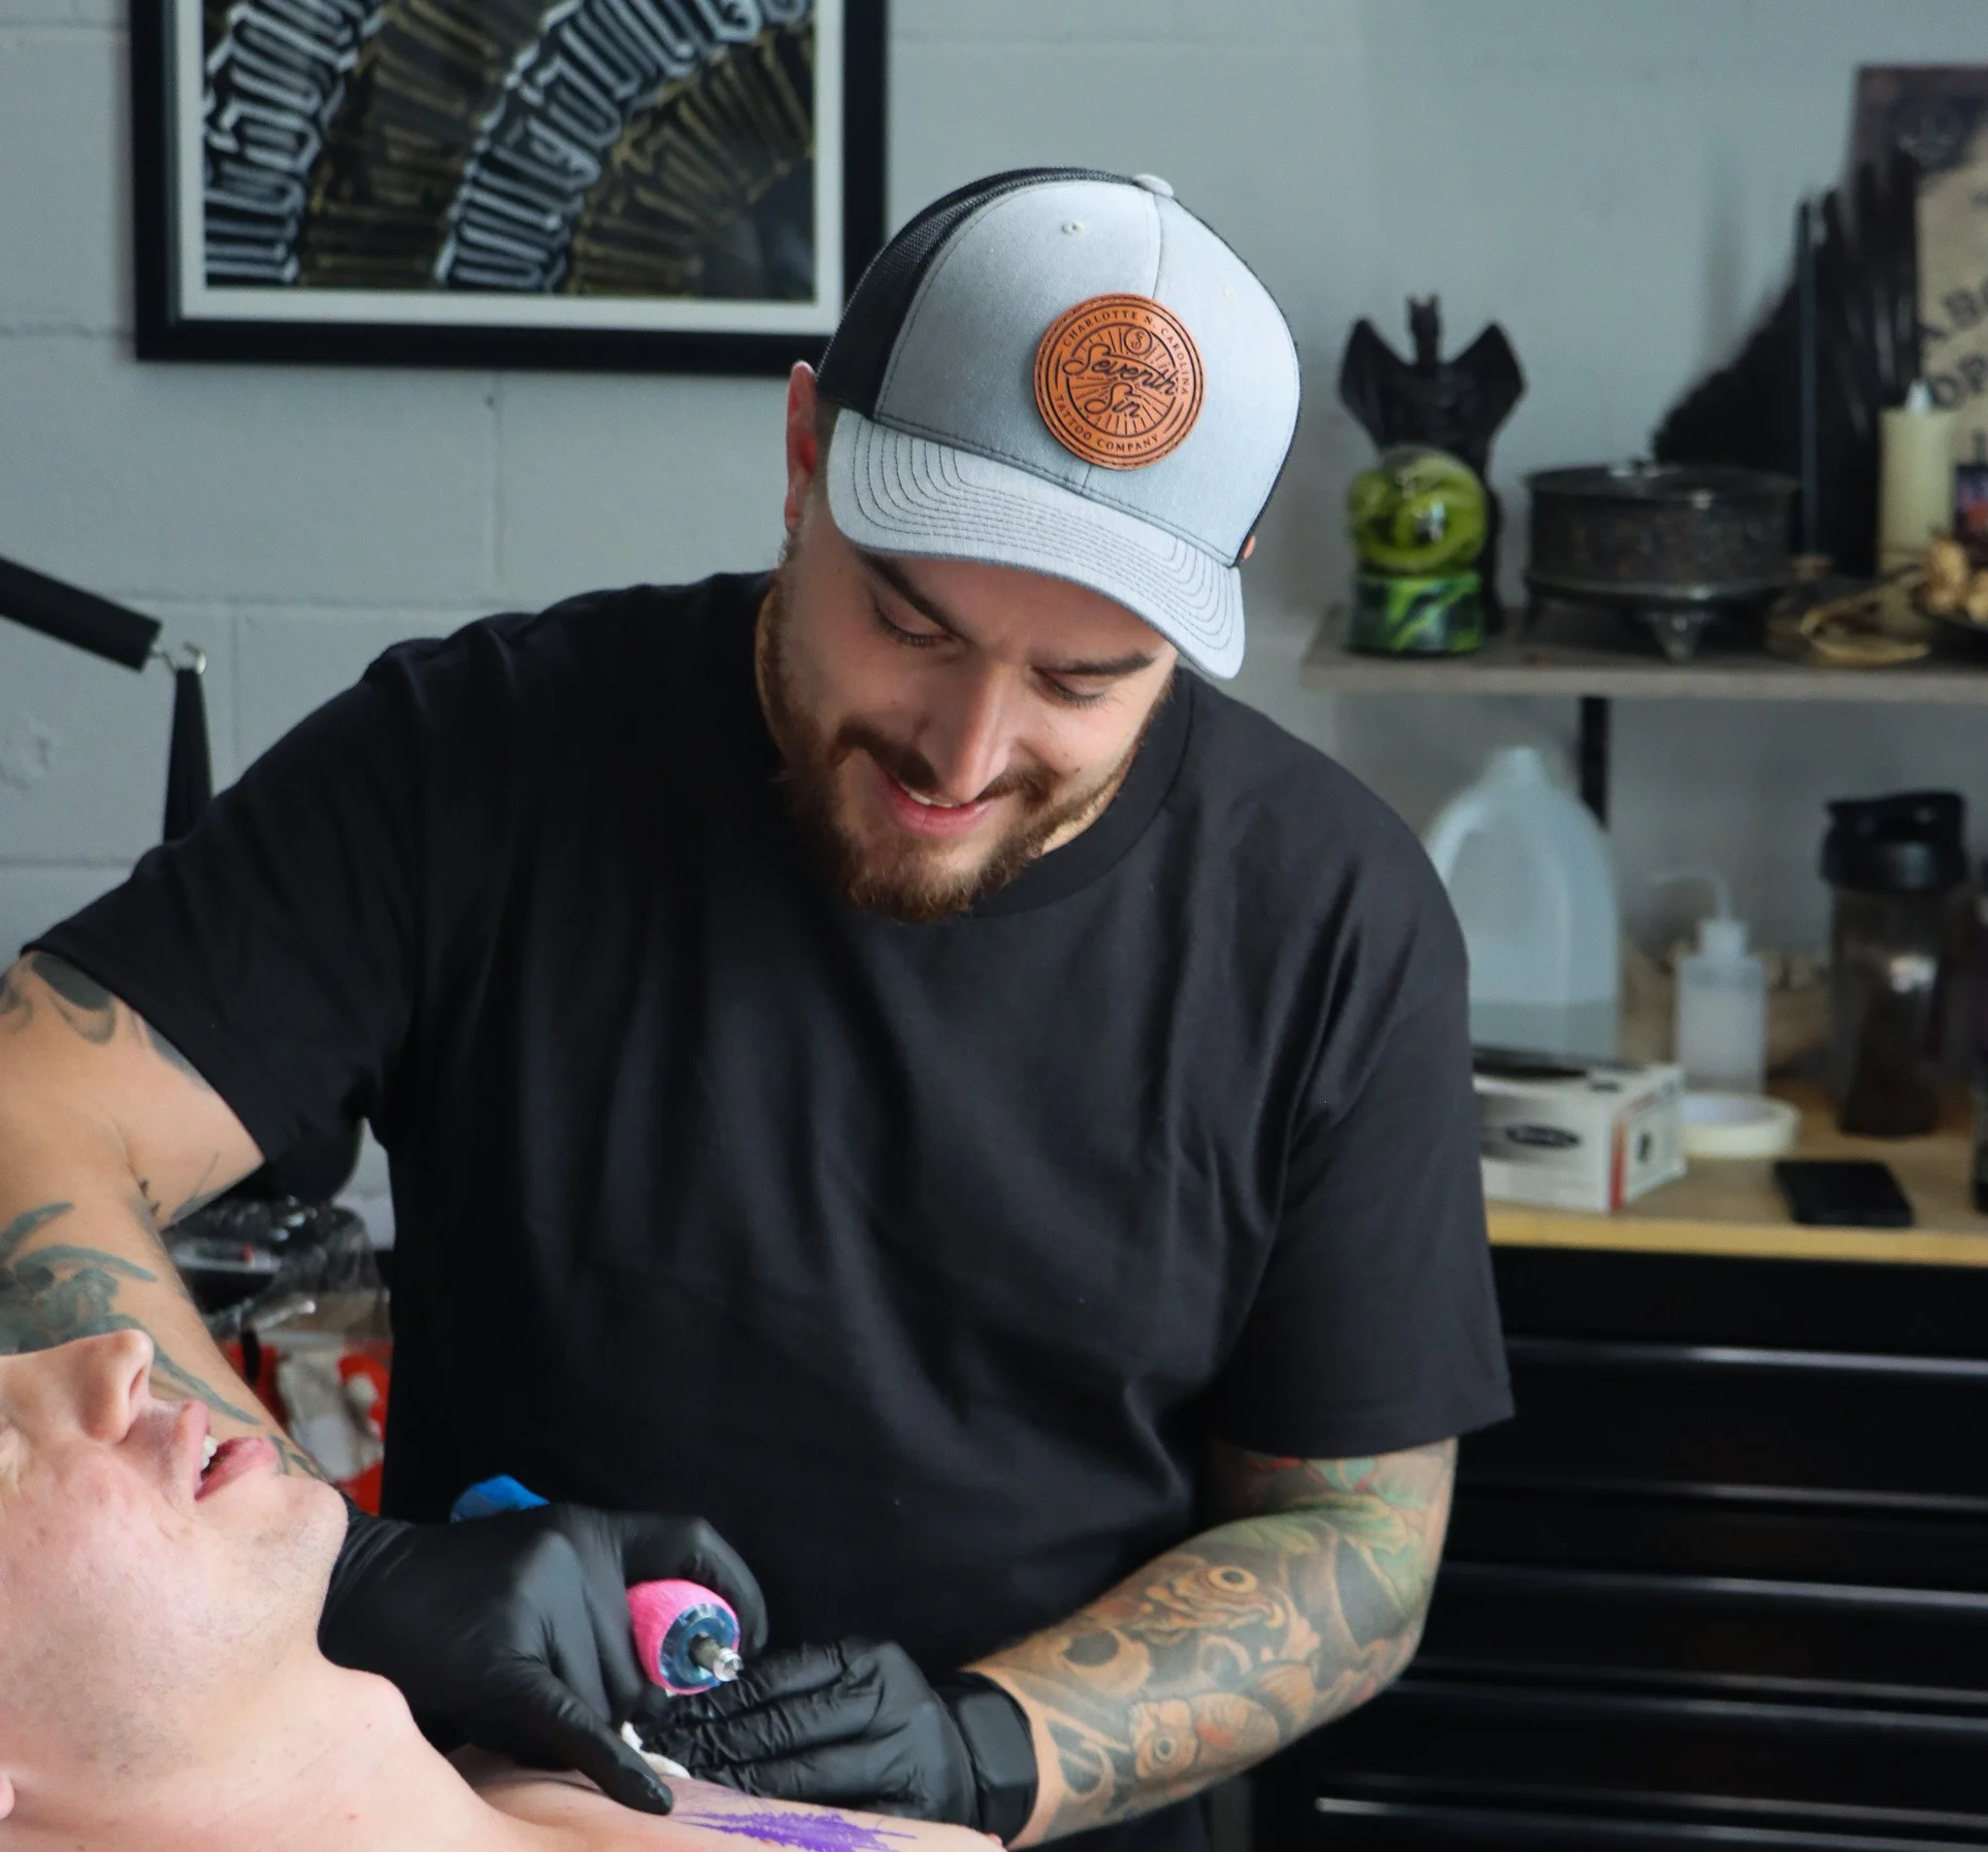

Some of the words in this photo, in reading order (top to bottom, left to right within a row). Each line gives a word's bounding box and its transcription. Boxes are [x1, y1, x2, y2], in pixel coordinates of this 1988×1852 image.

[1062, 343, 1179, 396] Seventh
[1063, 311, 1138, 347] CHARLOTTE
[1143, 315, 1155, 328] N.
[1161, 328, 1190, 395] CAROLINA
[1055, 394, 1093, 441] TATTOO
[1097, 434, 1159, 451] COMPANY
[1084, 382, 1141, 418] Sin
